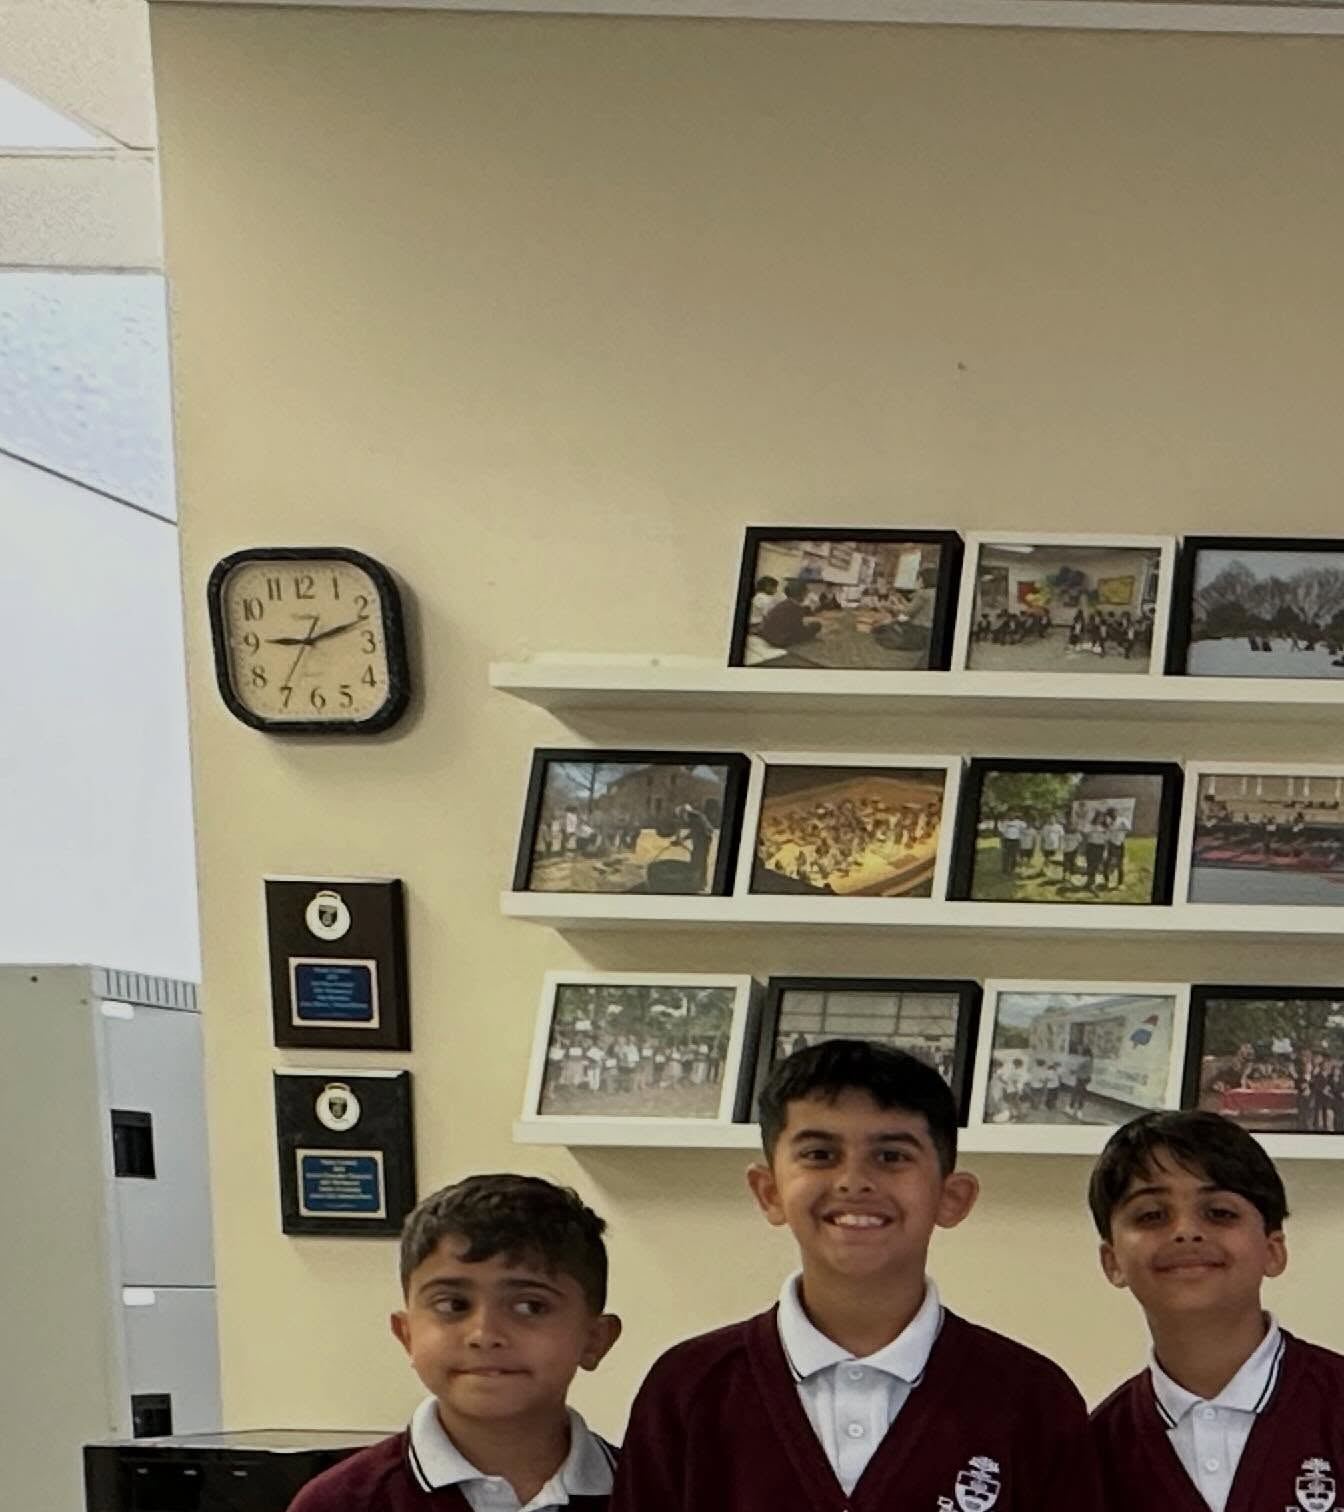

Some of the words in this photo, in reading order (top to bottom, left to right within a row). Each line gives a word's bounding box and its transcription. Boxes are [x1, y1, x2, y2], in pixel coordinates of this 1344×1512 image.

[266, 577, 282, 600] 11
[294, 575, 315, 600] 12
[242, 598, 264, 621] 10
[354, 595, 369, 620] 2
[243, 632, 260, 655] 9
[360, 630, 376, 654] 3
[252, 665, 267, 689] 8
[361, 664, 377, 688] 4
[279, 686, 293, 709] 7
[310, 687, 326, 709] 6
